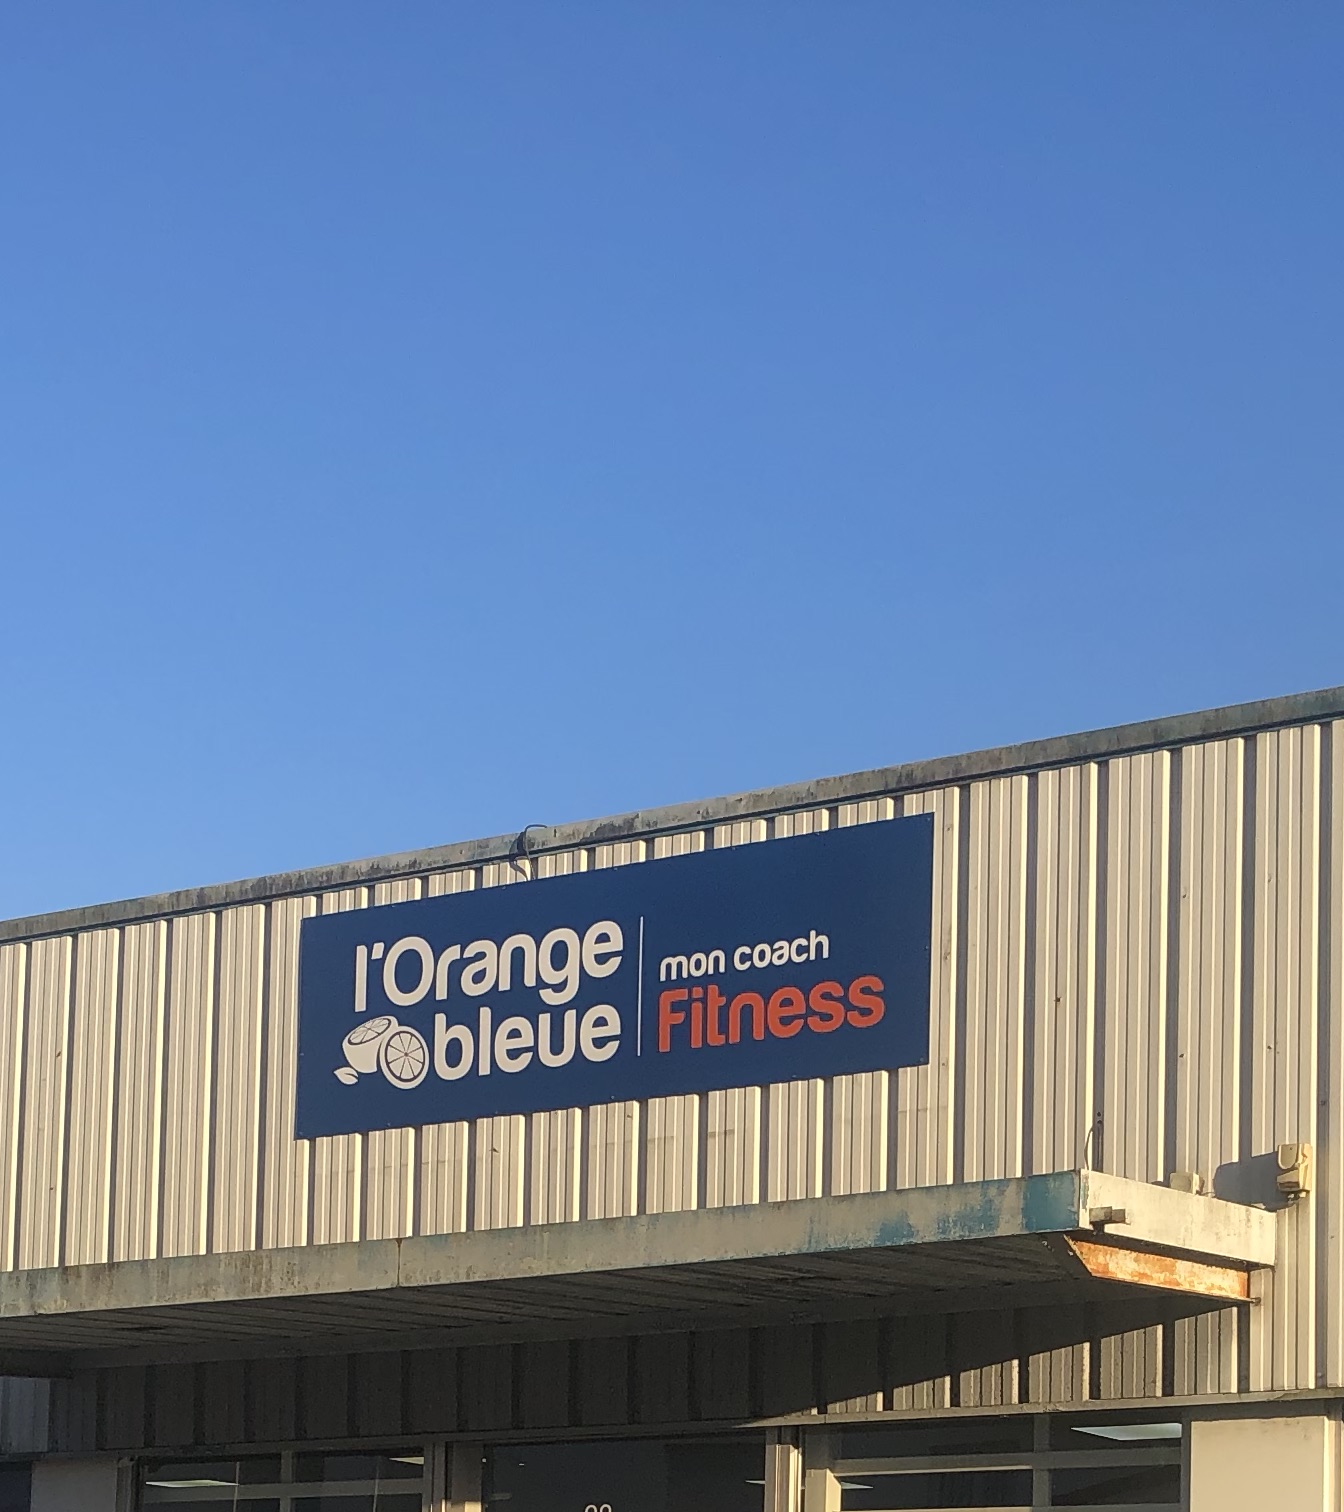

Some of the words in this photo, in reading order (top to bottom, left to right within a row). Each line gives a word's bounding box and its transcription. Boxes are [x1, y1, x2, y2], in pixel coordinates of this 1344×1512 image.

[355, 919, 624, 1013] l'Orange
[659, 949, 726, 982] mon
[733, 929, 830, 970] coach
[433, 1004, 623, 1082] bleue
[657, 974, 886, 1053] Fitness
